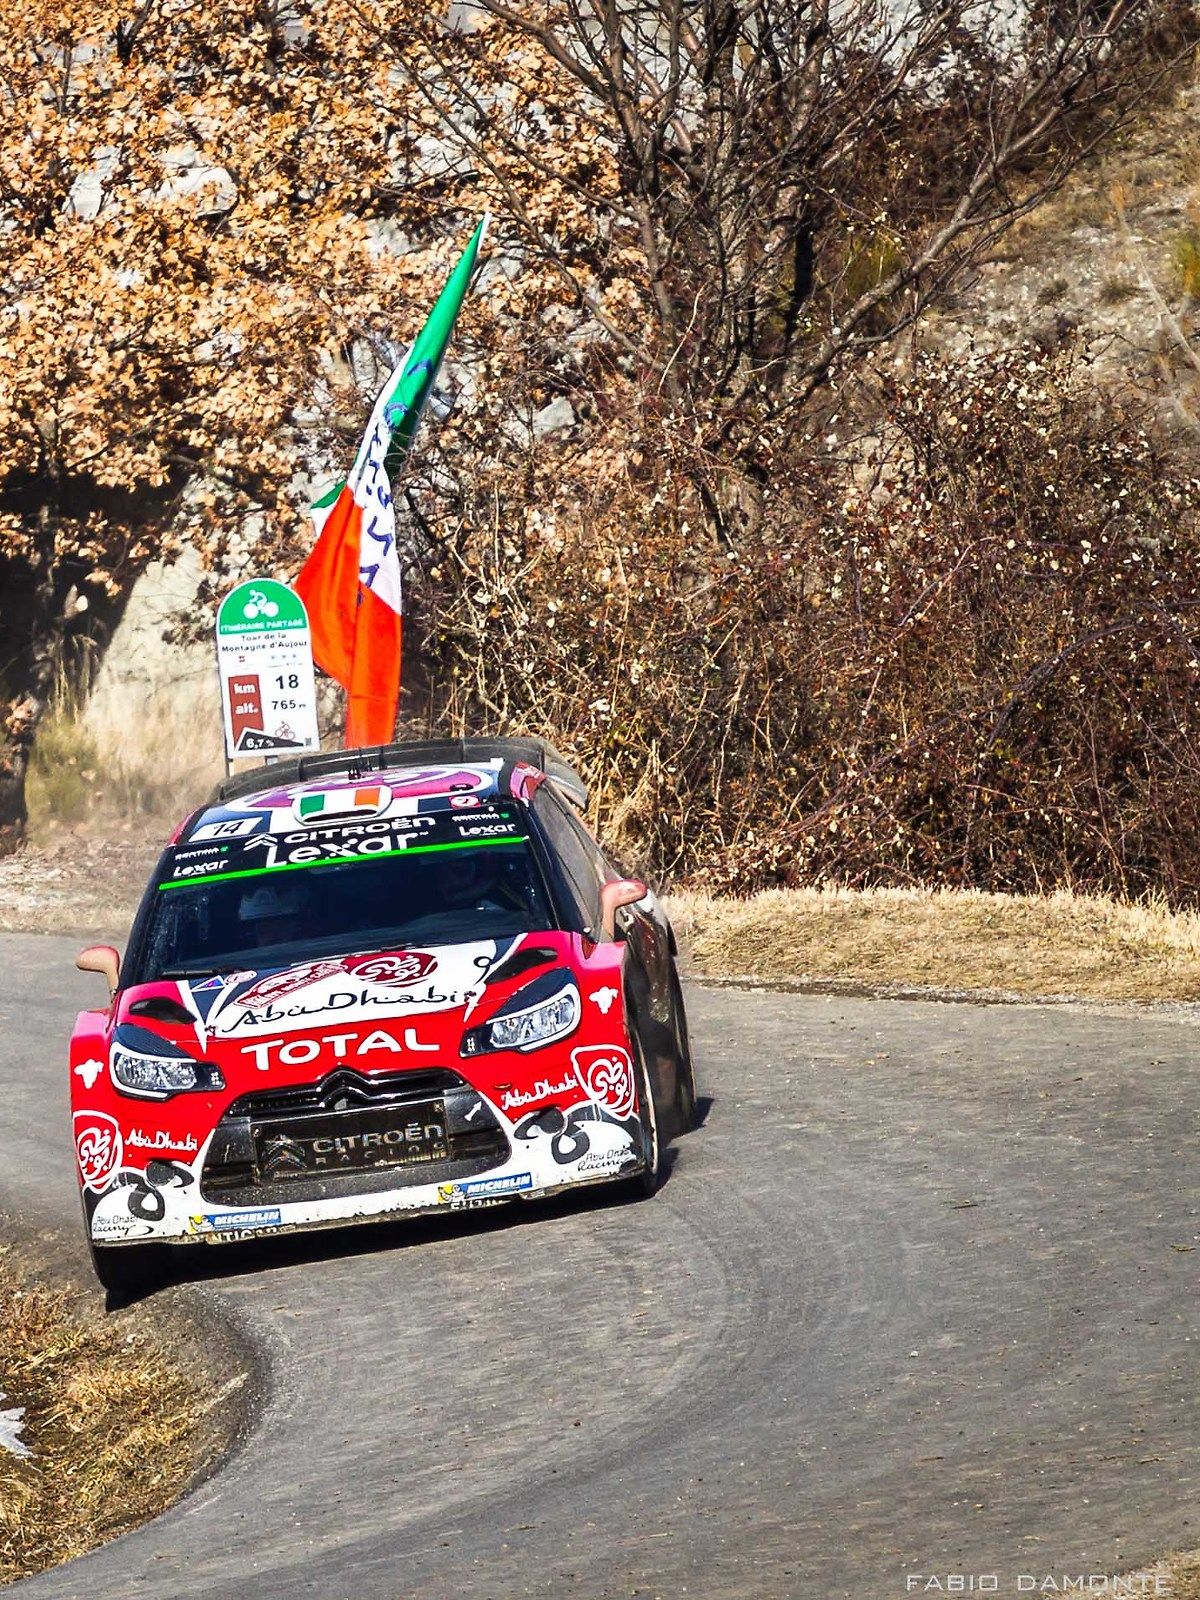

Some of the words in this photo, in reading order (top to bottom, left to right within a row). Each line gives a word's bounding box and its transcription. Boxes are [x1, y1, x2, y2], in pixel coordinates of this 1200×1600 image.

[241, 634, 261, 642] Tour
[264, 633, 276, 641] de
[278, 631, 287, 639] la
[221, 644, 266, 653] Montagne
[233, 683, 256, 694] km
[275, 674, 300, 690] 18
[235, 702, 259, 715] alt.
[271, 700, 297, 711] 765
[213, 820, 245, 836] 14
[284, 815, 436, 844] CITROËN
[458, 822, 516, 837] Lexar
[265, 831, 419, 869] Lexar
[173, 859, 229, 877] Lexar
[240, 1028, 441, 1071] TOTAL
[312, 1122, 444, 1154] CITROËN
[466, 1174, 531, 1194] MICHELIN
[214, 1210, 280, 1226] MICHELIN
